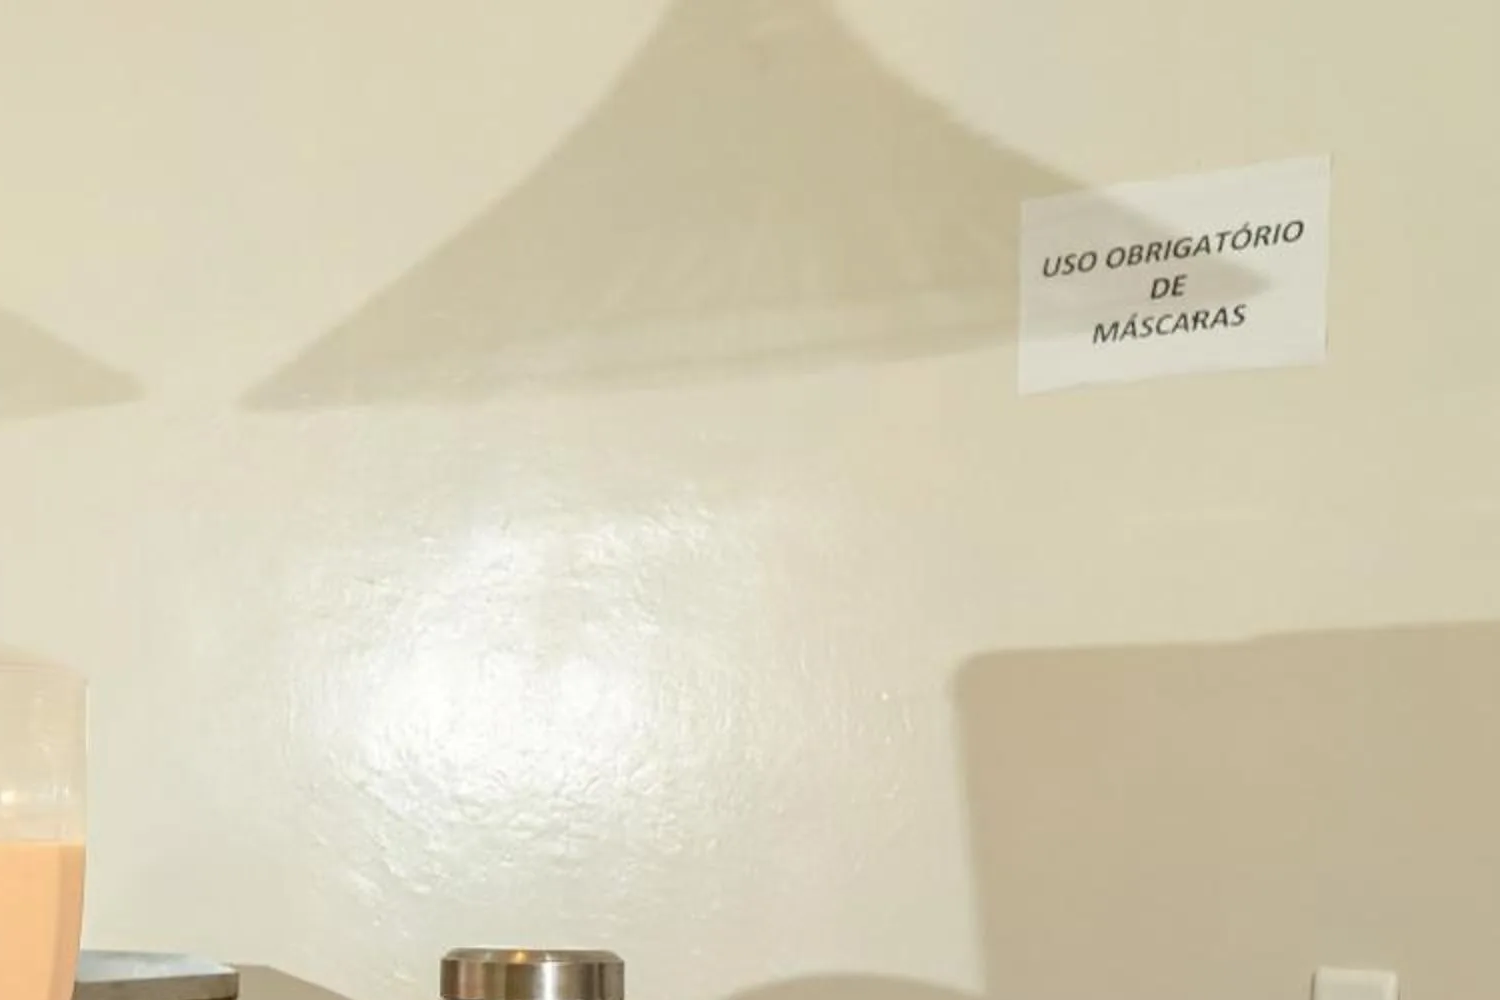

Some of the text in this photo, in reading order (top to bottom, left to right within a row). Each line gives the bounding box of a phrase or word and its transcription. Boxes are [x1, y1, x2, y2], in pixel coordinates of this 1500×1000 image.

[1042, 219, 1306, 278] USO OBRIGATÓRIO
[1149, 274, 1188, 300] DE
[1091, 303, 1248, 345] MÁSCARAS
